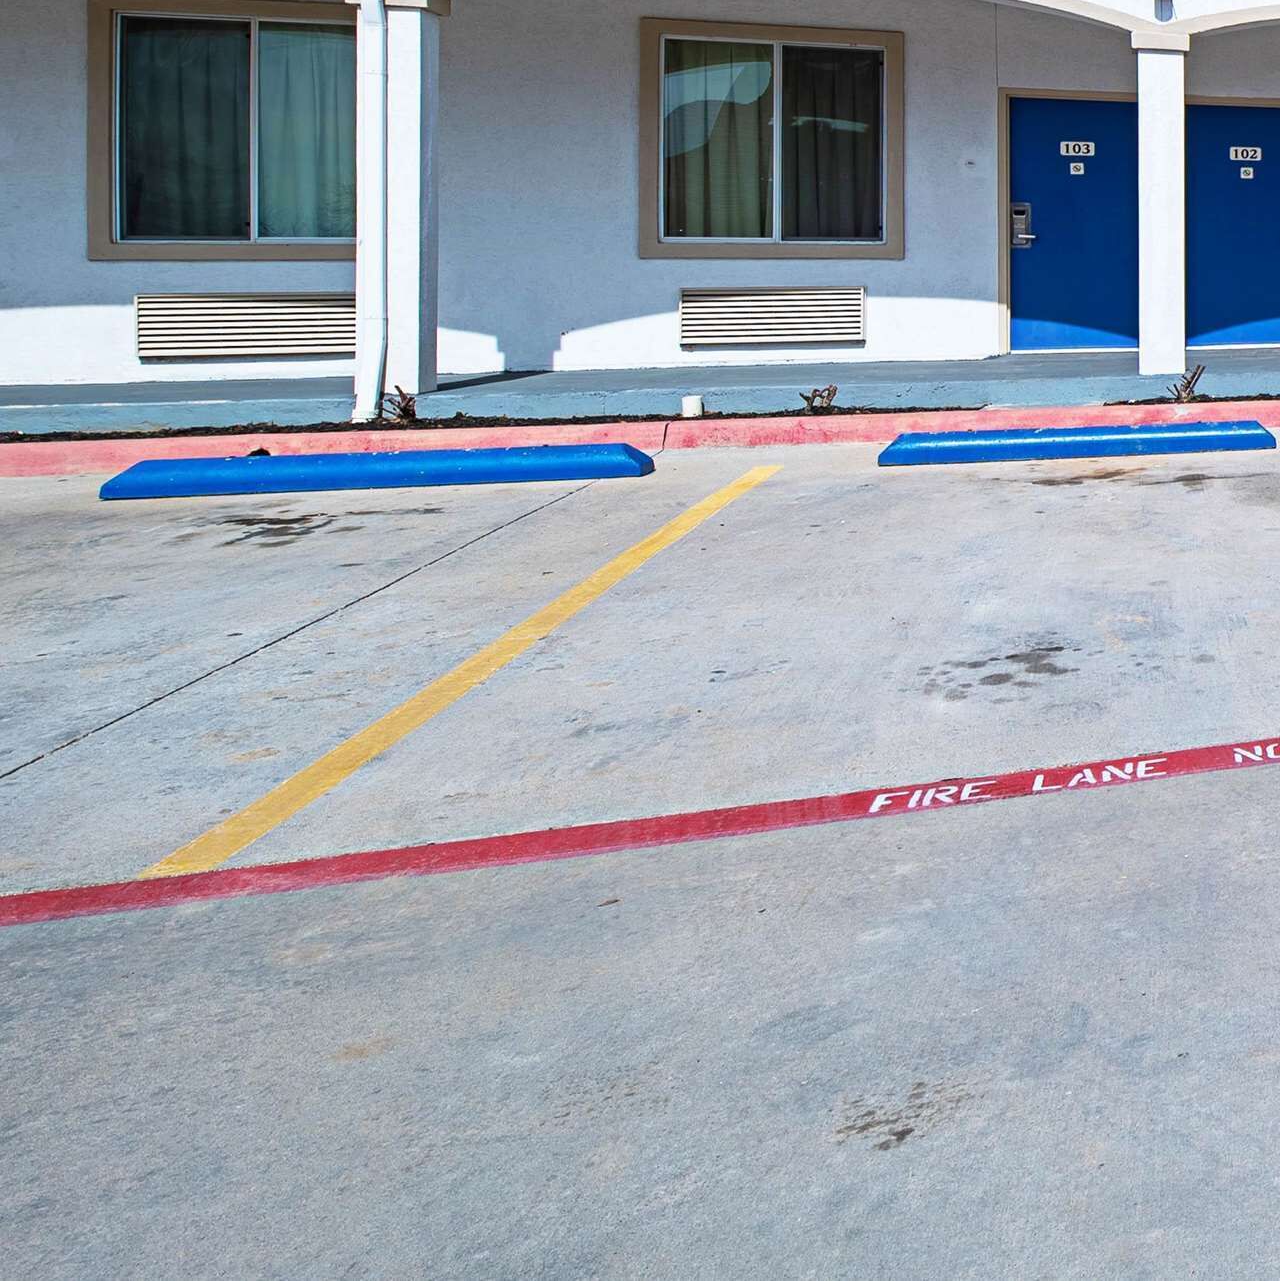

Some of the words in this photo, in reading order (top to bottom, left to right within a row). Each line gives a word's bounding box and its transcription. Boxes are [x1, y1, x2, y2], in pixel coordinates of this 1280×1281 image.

[1063, 143, 1091, 155] 103
[1233, 148, 1258, 159] 102
[869, 779, 997, 814] FIRE
[1031, 758, 1168, 793] LANE
